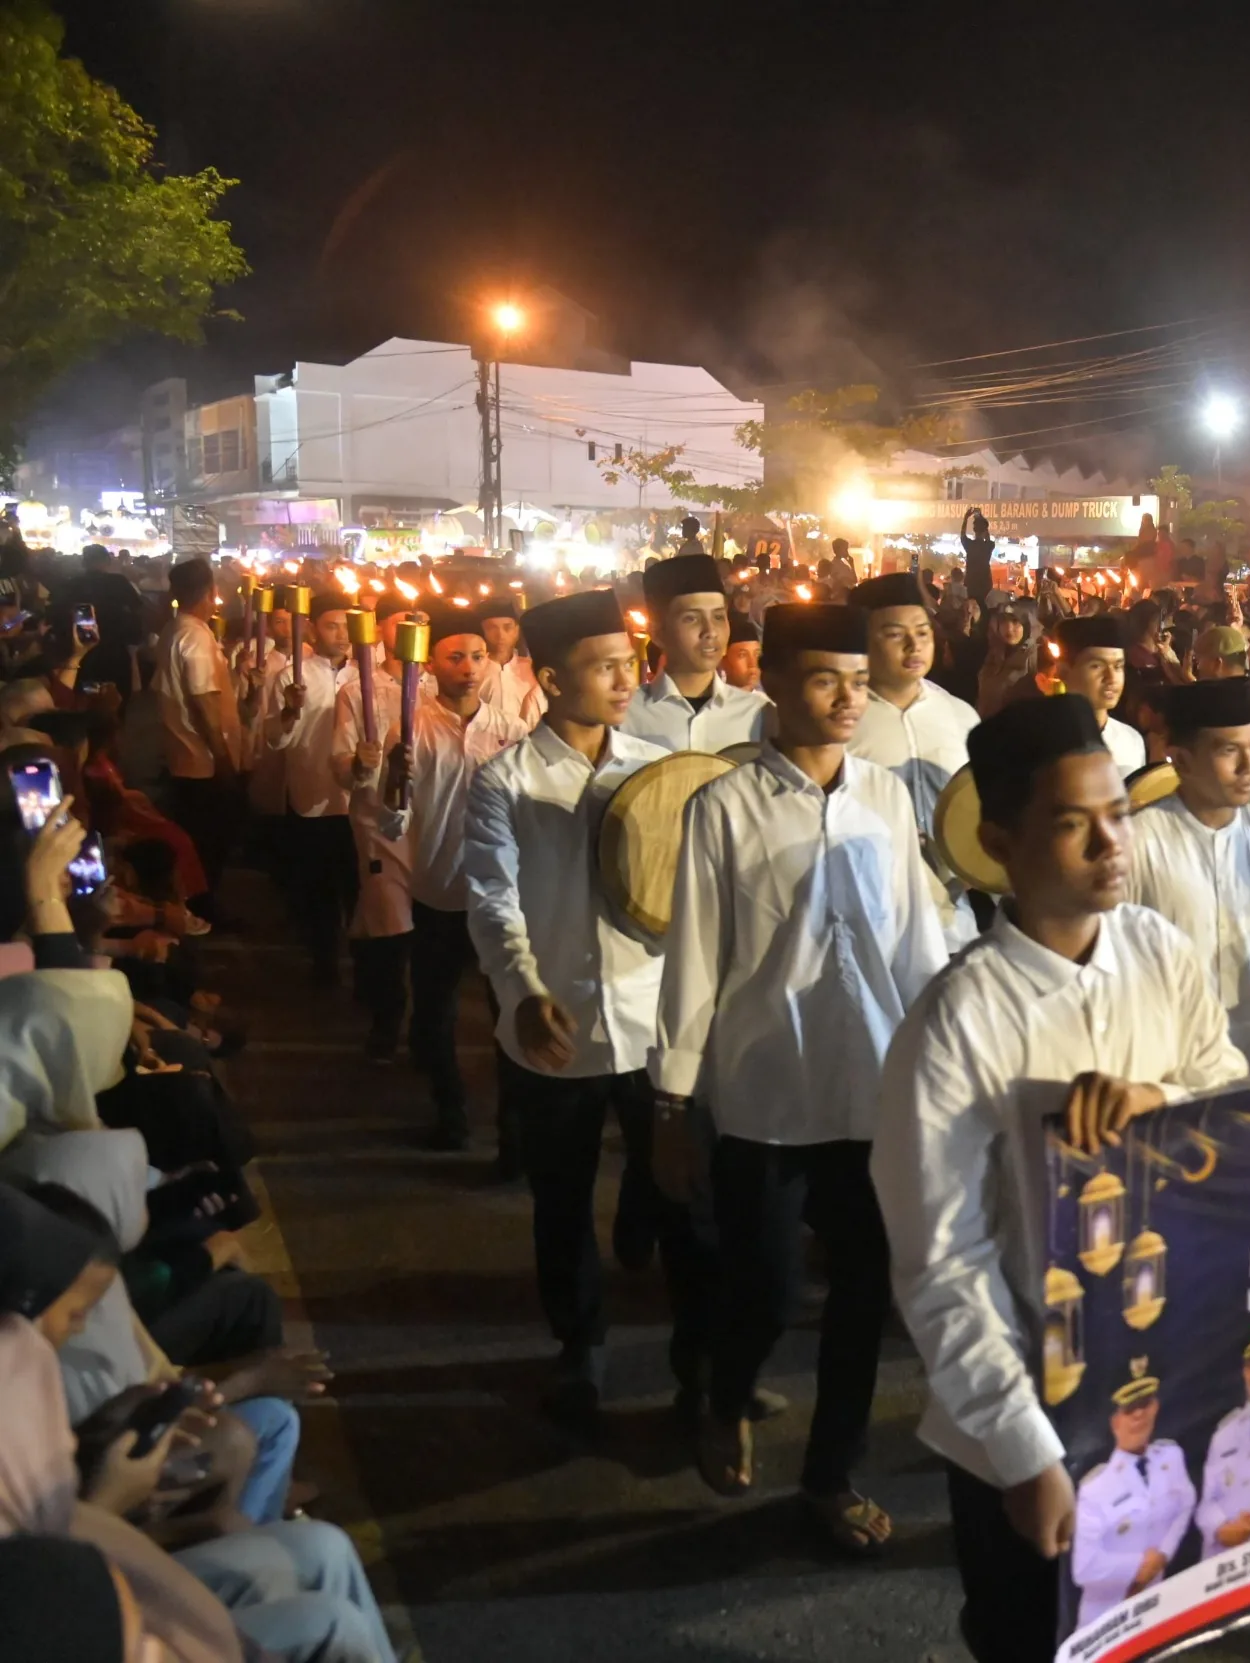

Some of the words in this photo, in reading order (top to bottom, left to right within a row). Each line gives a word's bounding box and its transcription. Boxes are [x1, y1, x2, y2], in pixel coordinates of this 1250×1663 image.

[1001, 503, 1039, 518] BARANG
[1041, 503, 1049, 518] &
[1051, 502, 1080, 518] DUMP
[1082, 501, 1118, 518] TRUCK
